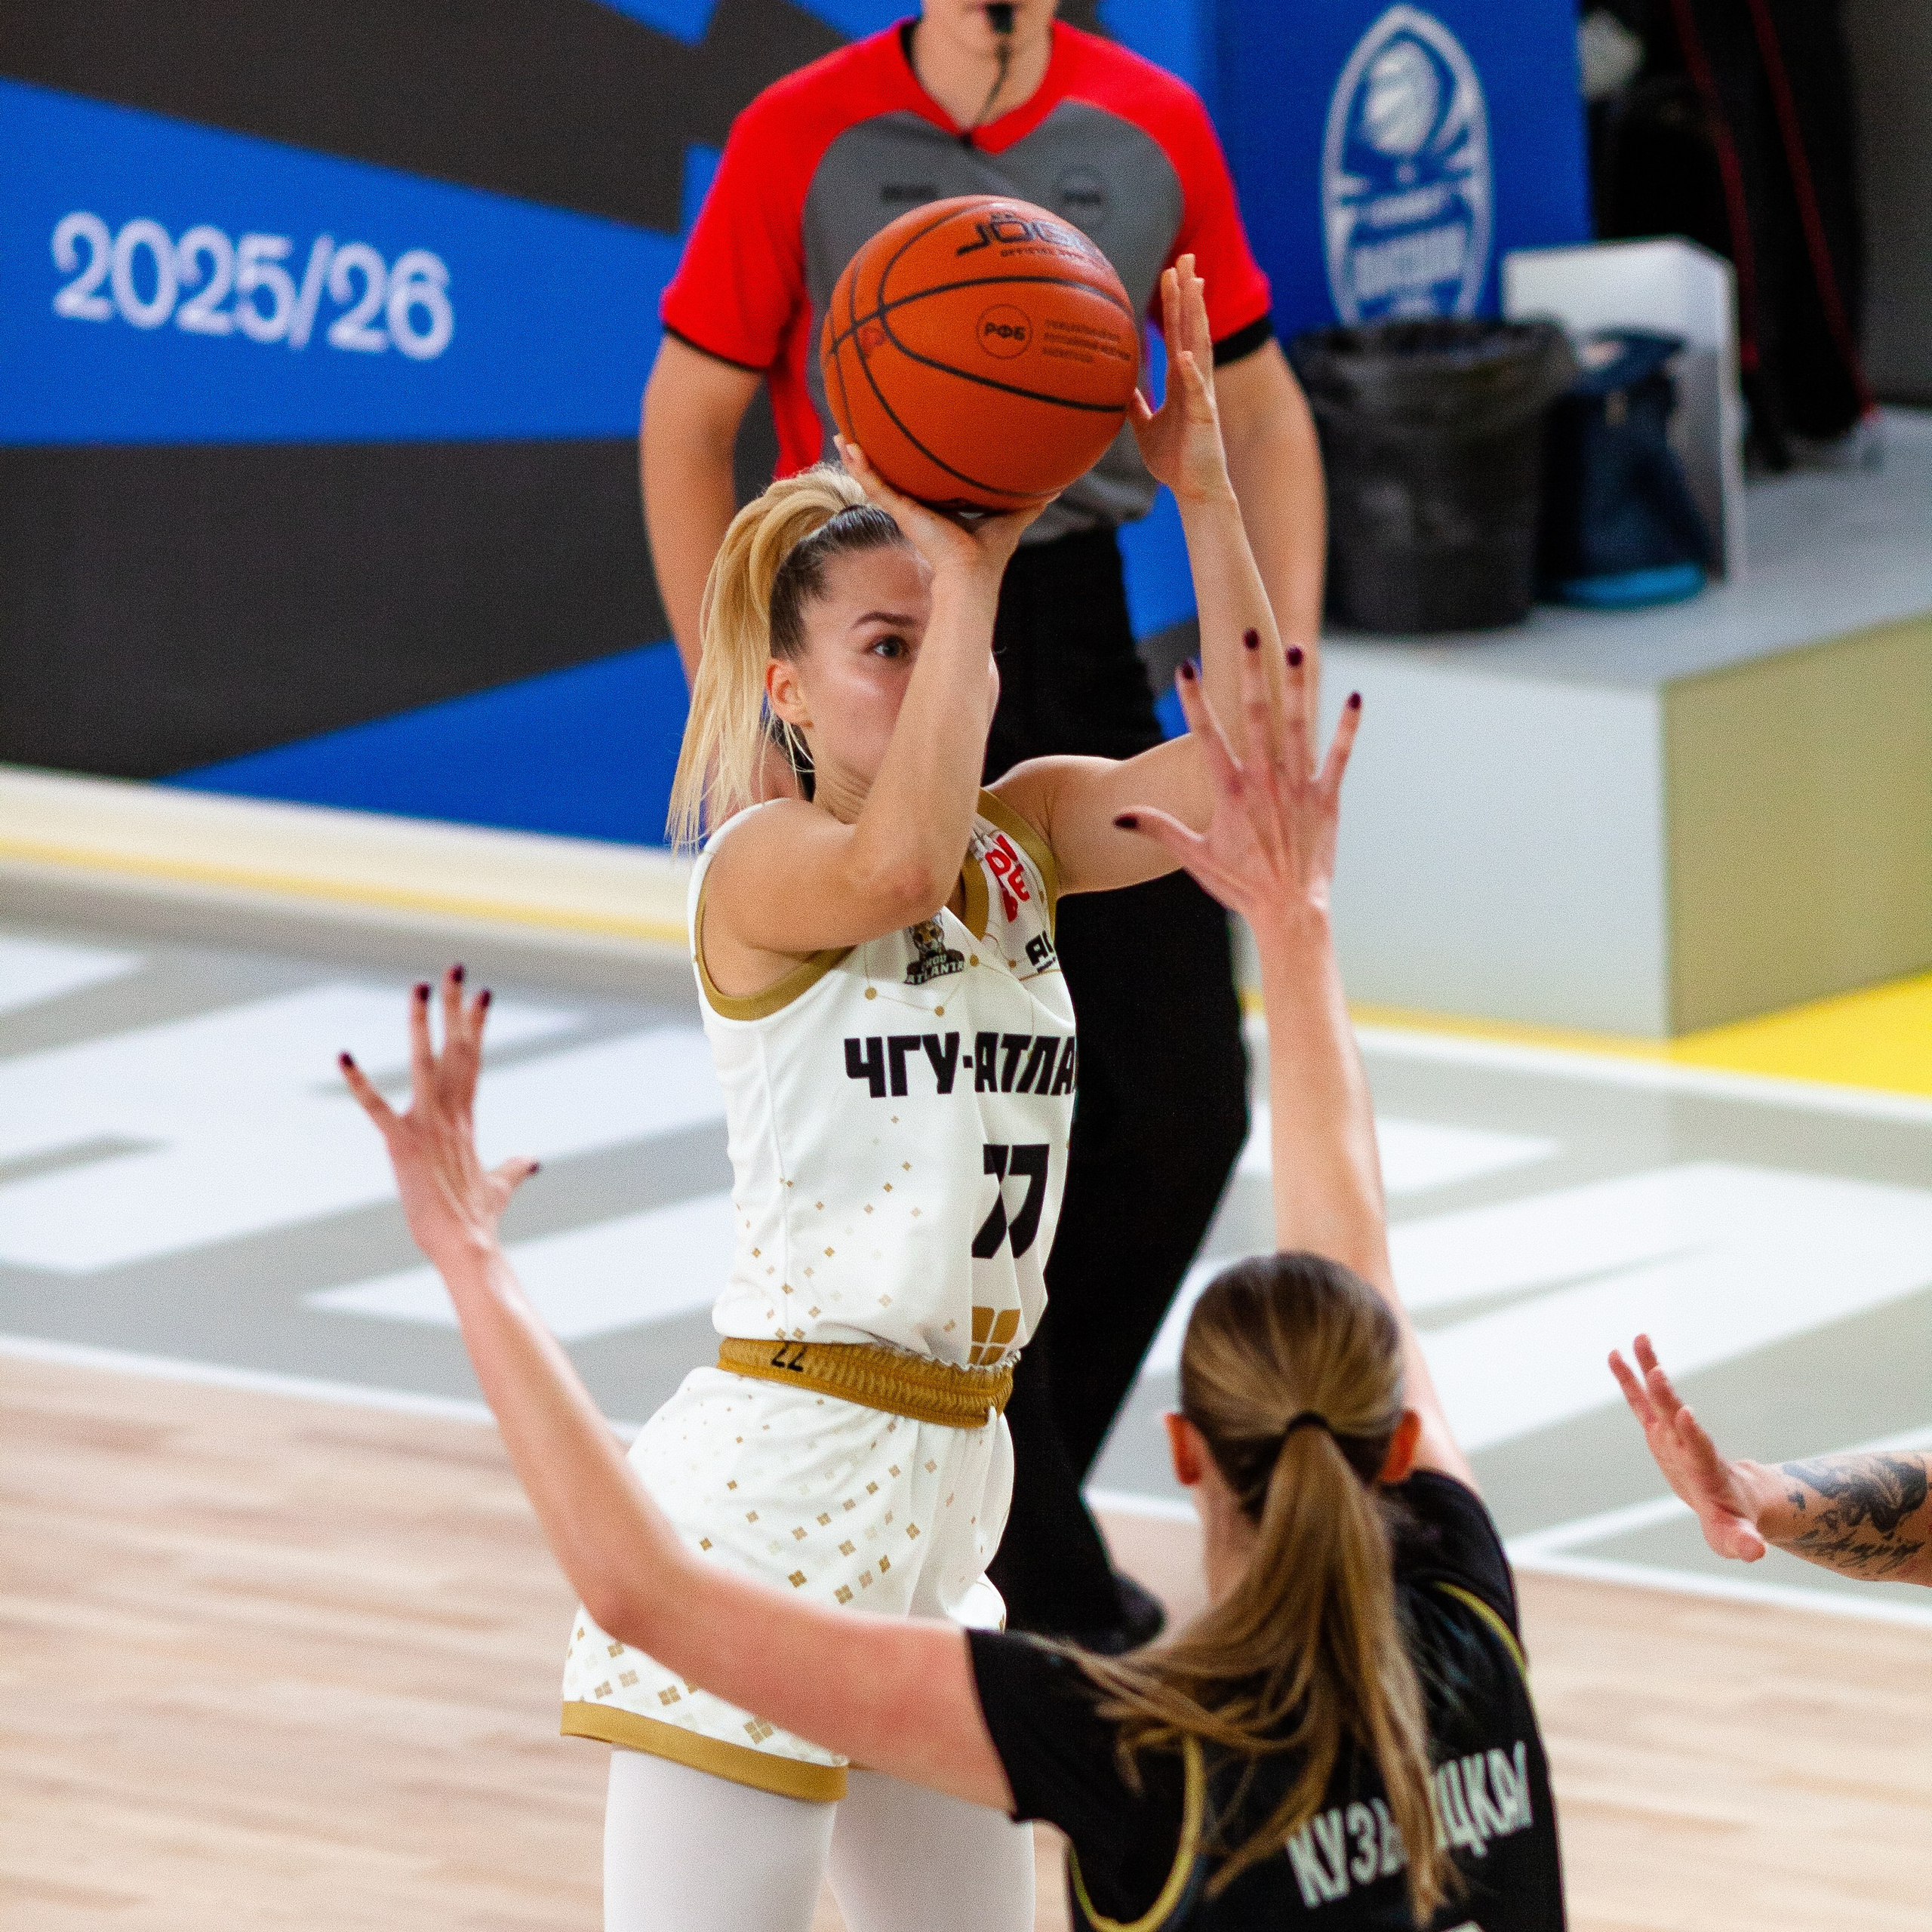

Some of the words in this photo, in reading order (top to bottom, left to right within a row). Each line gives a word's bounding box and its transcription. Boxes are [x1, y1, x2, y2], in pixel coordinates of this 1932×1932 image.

[51, 211, 454, 361] 2025/26
[983, 322, 1025, 341] РФБ
[971, 1143, 1050, 1259] 77
